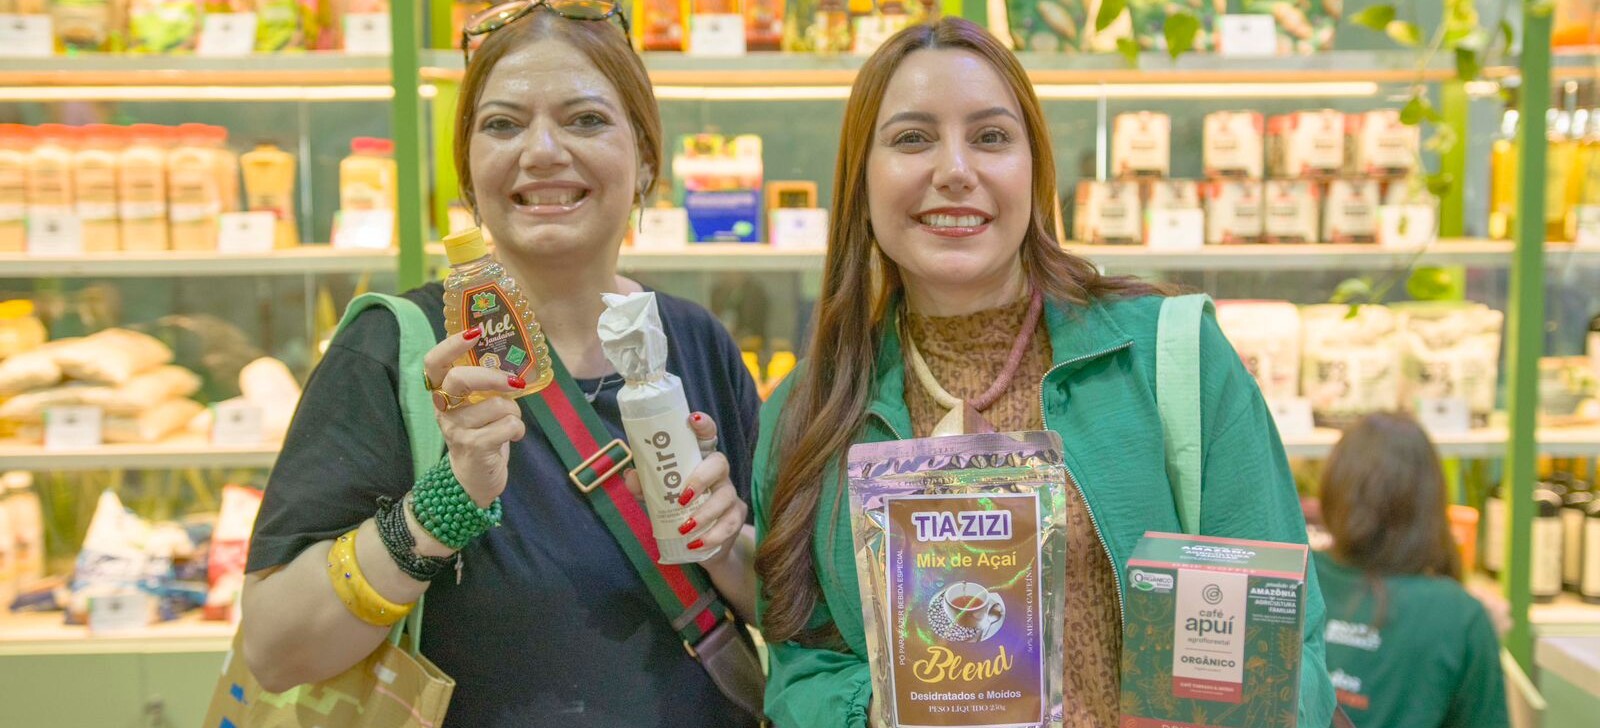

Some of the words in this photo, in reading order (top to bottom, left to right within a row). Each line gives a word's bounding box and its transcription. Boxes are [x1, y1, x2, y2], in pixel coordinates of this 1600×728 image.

[479, 314, 512, 338] Mel
[644, 431, 682, 504] toiró
[915, 516, 957, 538] TIA
[961, 514, 1009, 536] ZIZI
[917, 553, 946, 568] Mix
[951, 553, 972, 568] de
[978, 551, 1017, 570] Açaí
[1250, 588, 1297, 598] AMAZÔNIA
[1199, 609, 1224, 619] café
[1185, 615, 1235, 637] apuí
[913, 645, 1014, 683] Blend
[1181, 655, 1236, 668] ORGÂNICO
[910, 691, 976, 701] Desidratados
[928, 705, 950, 713] PESO
